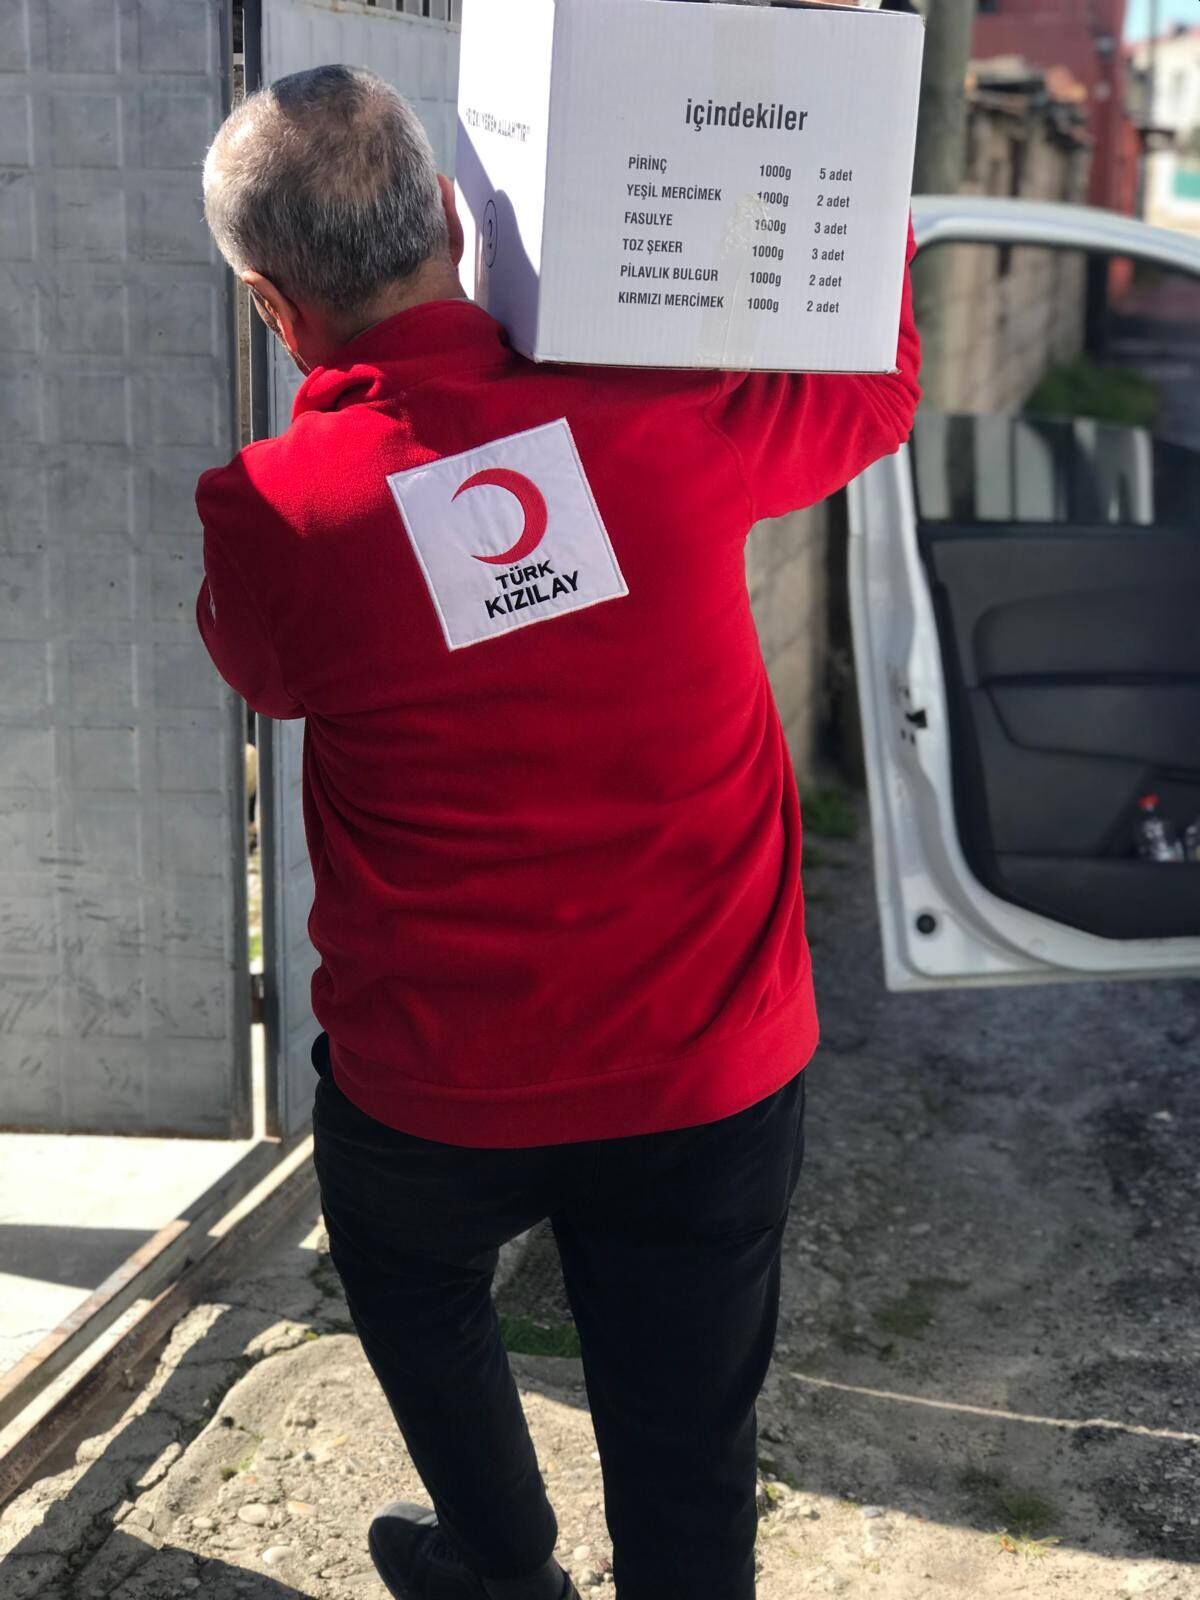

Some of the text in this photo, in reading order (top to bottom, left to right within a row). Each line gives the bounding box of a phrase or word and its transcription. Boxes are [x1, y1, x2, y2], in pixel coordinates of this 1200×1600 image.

[686, 98, 808, 132] içindekiler
[629, 154, 852, 181] PİRİNÇ 1000g 5 adet
[627, 182, 849, 207] YEŞİL MERCİMEK 1000g 2 adet
[625, 212, 847, 235] FASULYE 1000g 3 adet
[623, 238, 844, 261] TOZ ŞEKER 1000g 3 adet
[620, 263, 842, 287] PİLAVLIK BULGUR 1000g 2 adet
[619, 292, 839, 313] KIRMIZI MERCİMEK 1000g 2 adet
[495, 559, 555, 590] TÜRK
[484, 570, 579, 619] KIZILAY
